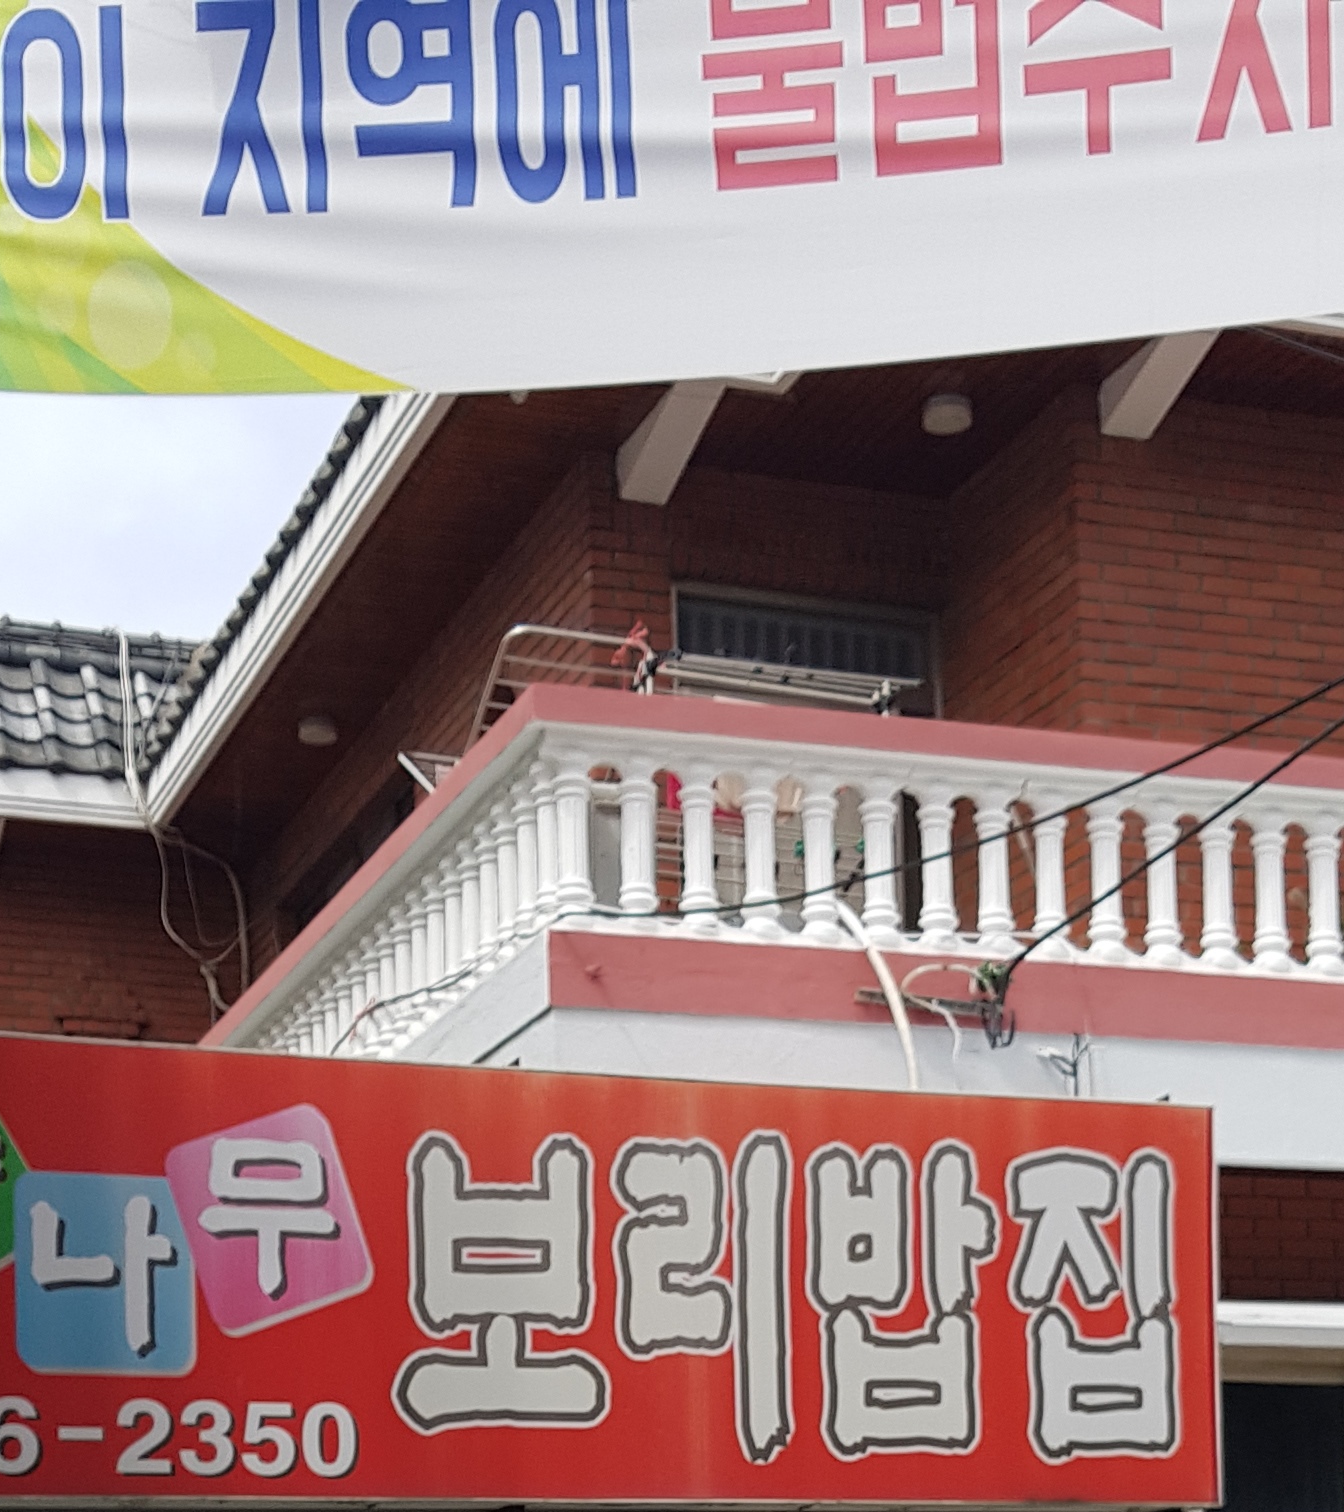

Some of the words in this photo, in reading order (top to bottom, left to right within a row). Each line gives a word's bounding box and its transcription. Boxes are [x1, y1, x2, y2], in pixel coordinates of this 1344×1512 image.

[1, 6, 129, 222] 이
[201, 0, 639, 216] 지역에
[390, 1128, 1181, 1463] 보리밥집
